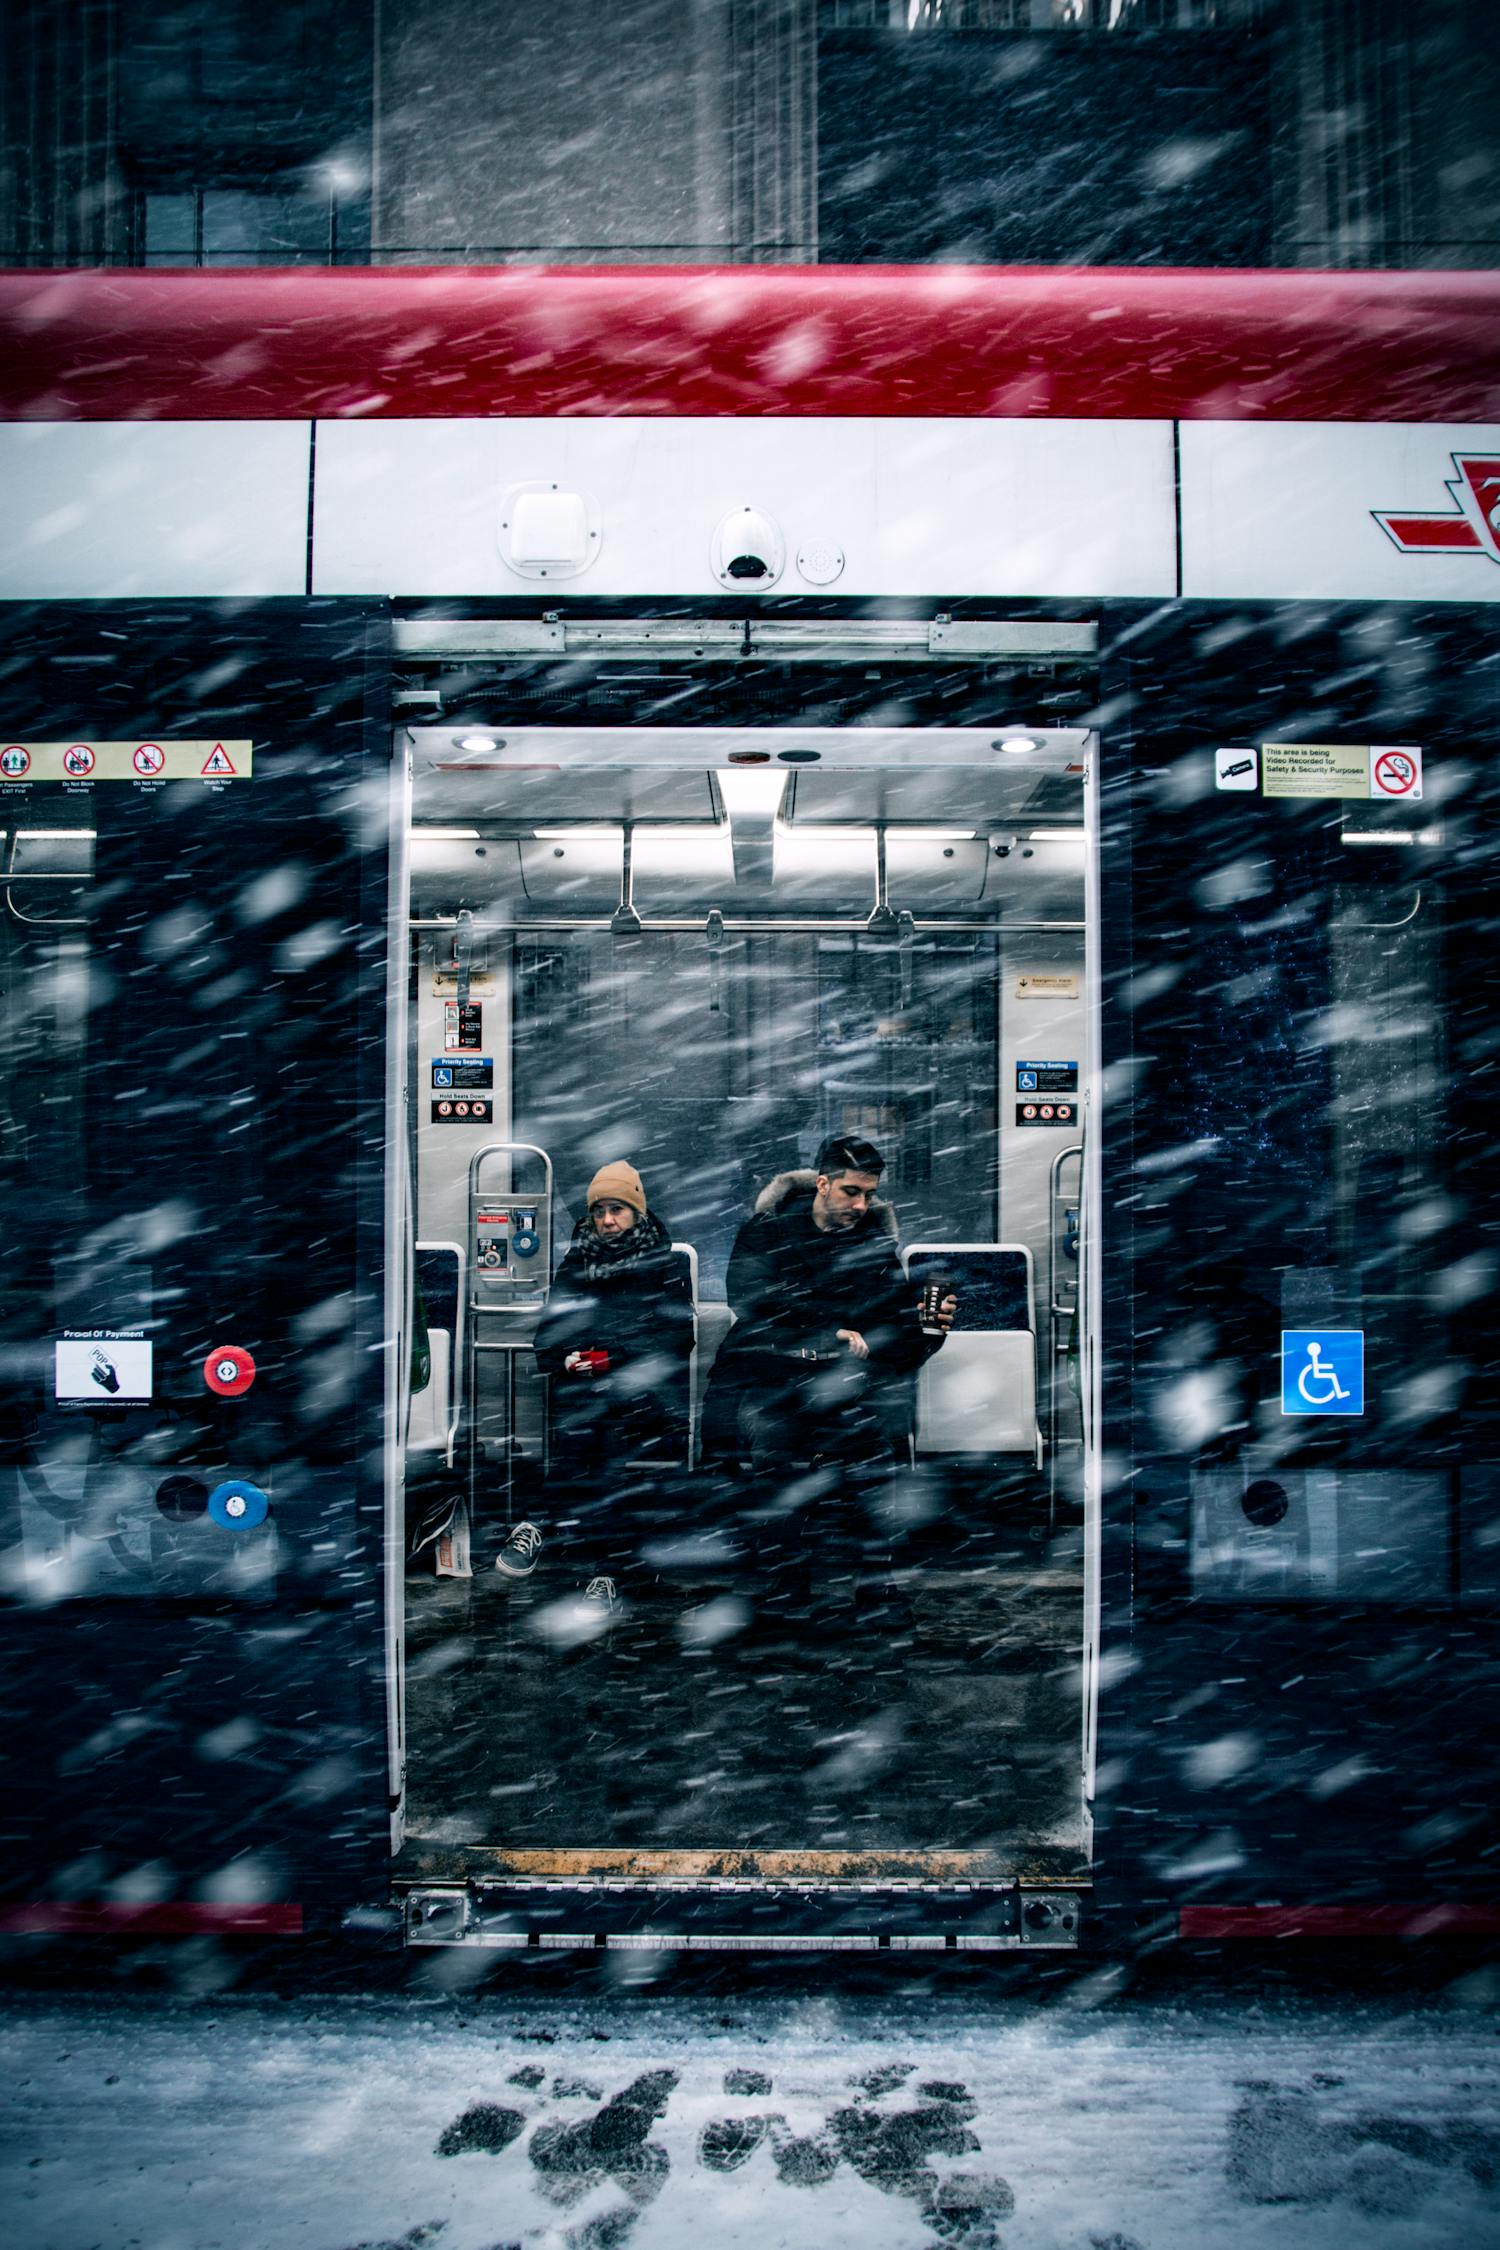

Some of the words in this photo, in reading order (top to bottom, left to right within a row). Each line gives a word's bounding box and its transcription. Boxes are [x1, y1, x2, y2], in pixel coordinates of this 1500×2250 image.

[1310, 749, 1330, 757] being
[1266, 766, 1289, 774] Safety
[1298, 766, 1328, 774] Security
[1330, 766, 1364, 775] Purposes
[63, 1330, 92, 1338] Proof
[93, 1330, 103, 1338] Of
[105, 1330, 144, 1339] Payment
[92, 1349, 108, 1364] POP
